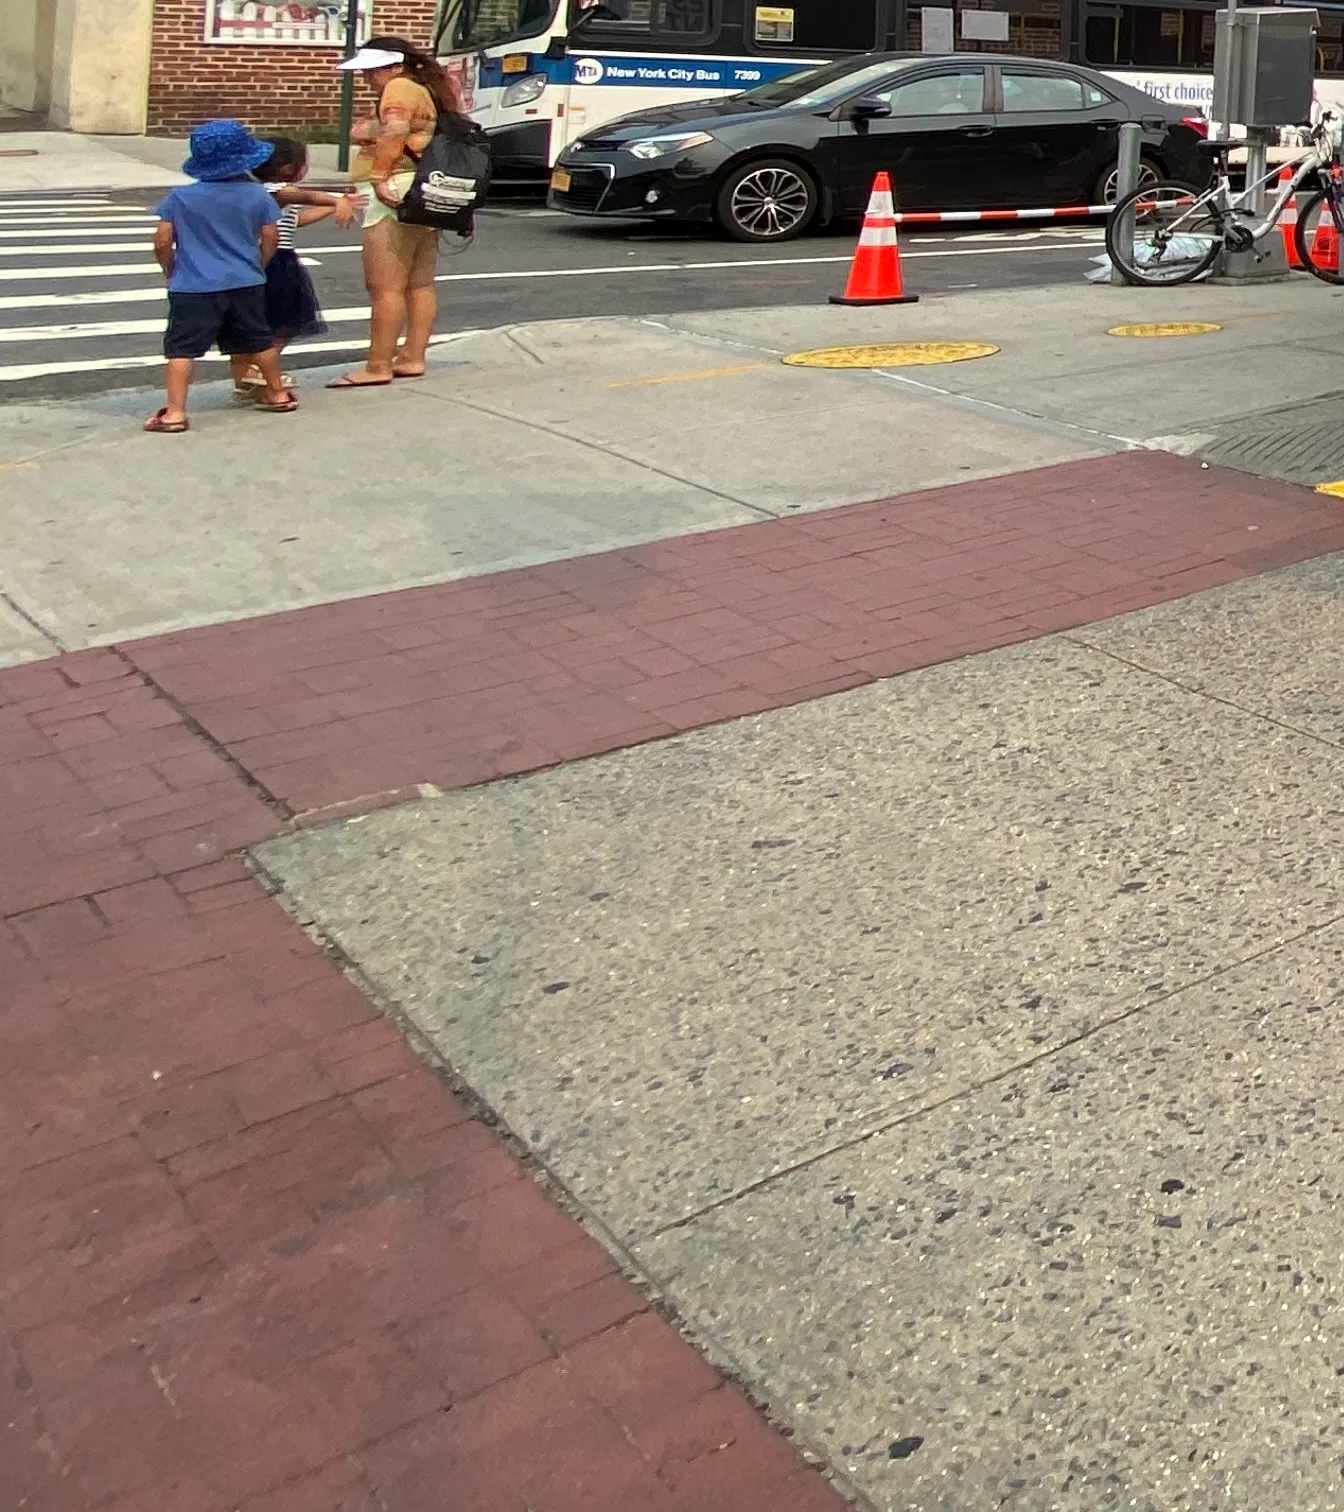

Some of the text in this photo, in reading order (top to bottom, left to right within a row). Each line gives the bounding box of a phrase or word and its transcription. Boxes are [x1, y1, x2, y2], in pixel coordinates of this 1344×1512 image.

[607, 66, 635, 78] New
[637, 67, 666, 79] York
[668, 68, 694, 82] City
[696, 70, 720, 81] Bus
[734, 70, 761, 80] 7399
[1143, 82, 1171, 101] first
[1174, 82, 1213, 101] choice
